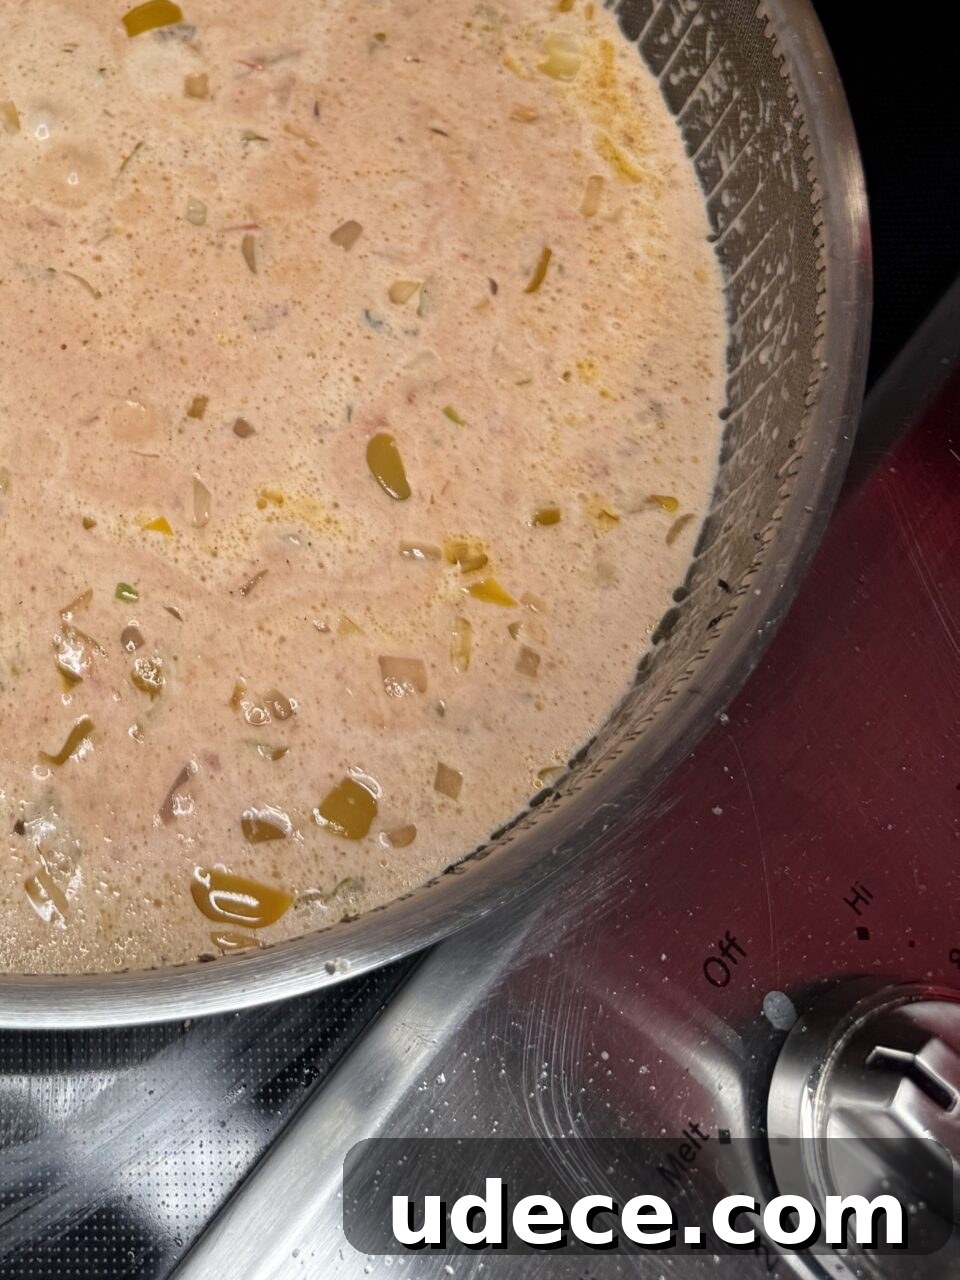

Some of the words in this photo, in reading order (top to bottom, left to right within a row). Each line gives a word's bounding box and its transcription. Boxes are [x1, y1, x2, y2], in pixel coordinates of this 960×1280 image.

[842, 880, 874, 916] Hi
[702, 930, 747, 988] Off
[656, 1121, 711, 1188] Melt
